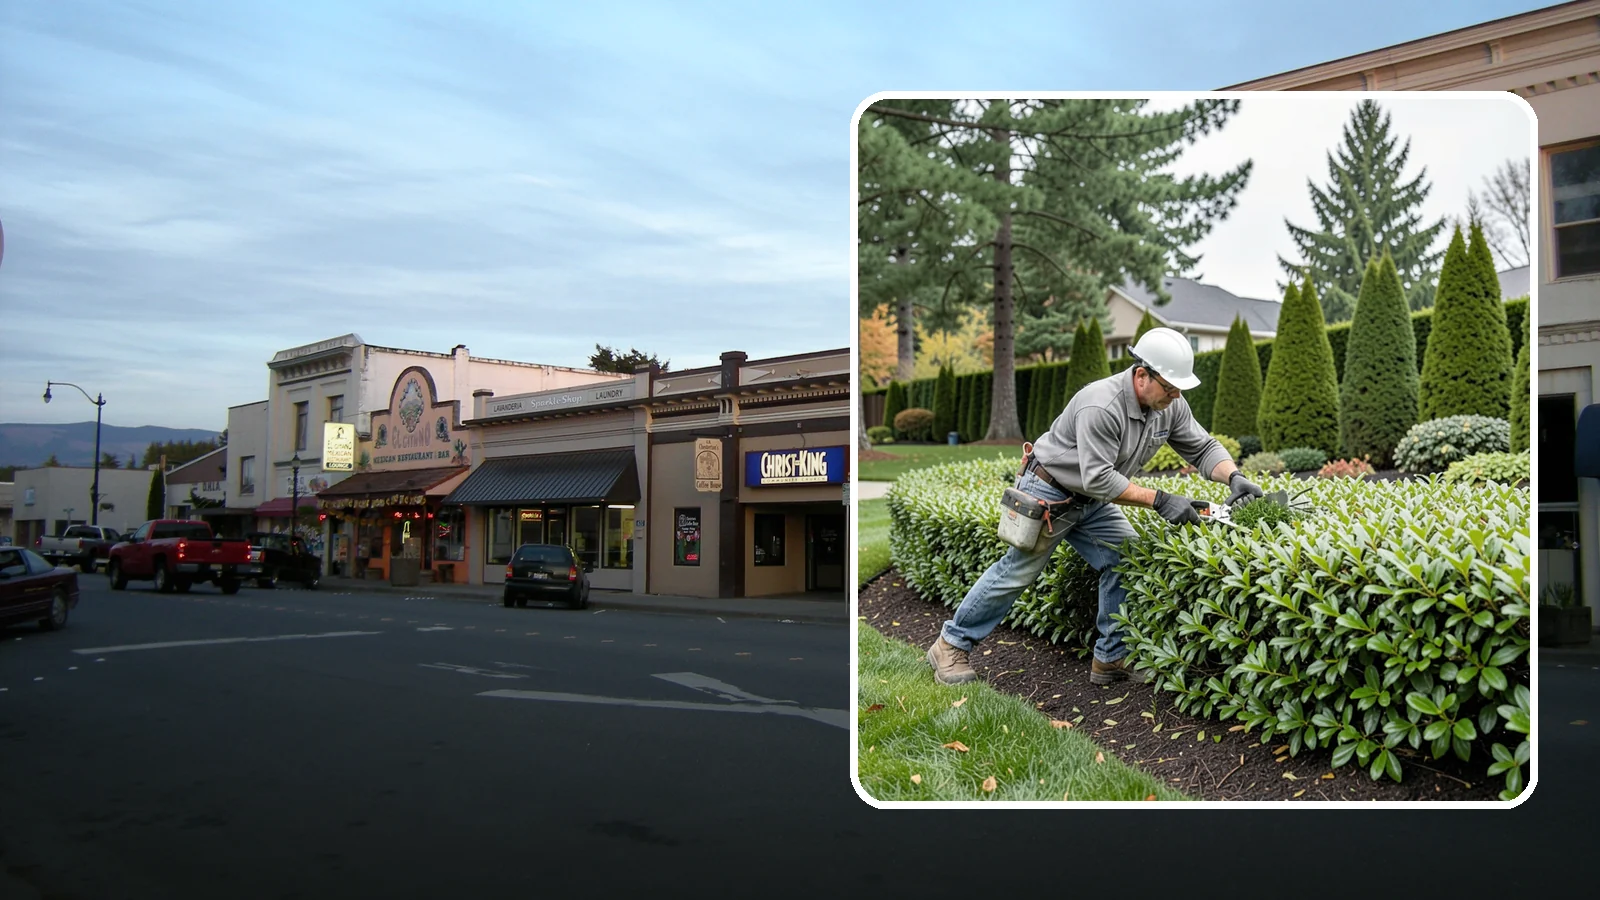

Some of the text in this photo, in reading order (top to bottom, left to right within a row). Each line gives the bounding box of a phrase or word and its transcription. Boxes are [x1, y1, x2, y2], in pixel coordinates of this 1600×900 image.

[494, 389, 623, 412] LAVANDERIA Sparkle Shop LAUNDRY
[373, 450, 449, 464] MEXICAN RESTAURANT BAR
[761, 450, 827, 477] CHRIST KING
